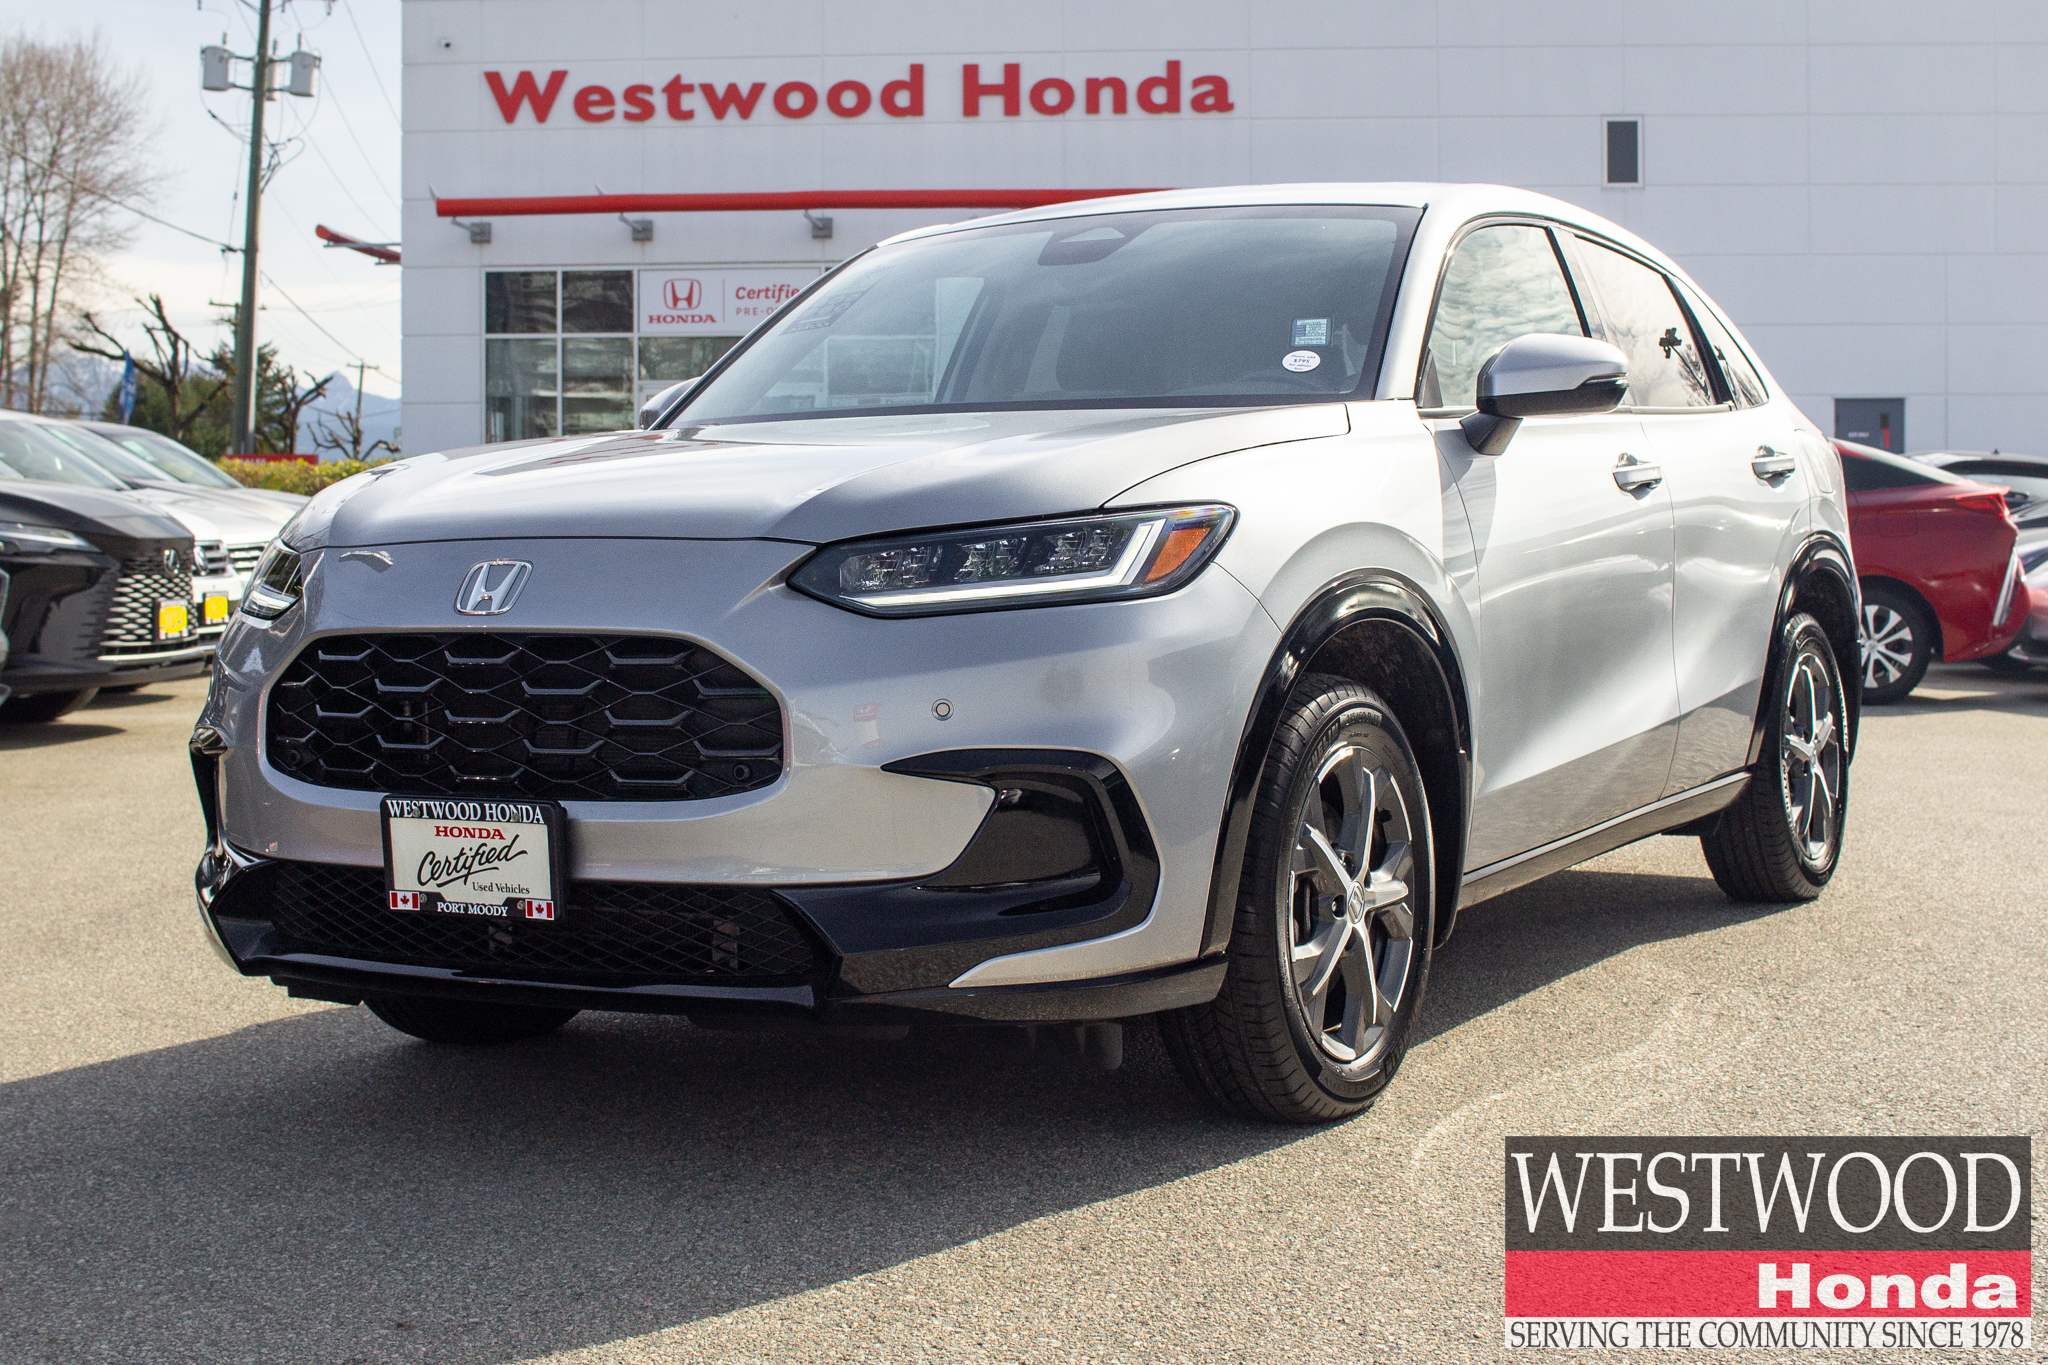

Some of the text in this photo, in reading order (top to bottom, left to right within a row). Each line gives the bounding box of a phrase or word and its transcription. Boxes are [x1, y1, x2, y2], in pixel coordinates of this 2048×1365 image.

[483, 60, 1234, 124] Westwood Honda
[735, 284, 801, 303] Certifie
[648, 314, 717, 324] HONDA
[736, 307, 775, 317] PRE-O
[386, 799, 545, 824] WESTWOOD HONDA
[434, 825, 506, 840] HONDA
[416, 834, 528, 887] Certified
[472, 881, 530, 895] Used Vehicles
[437, 901, 508, 917] PORT MOODY
